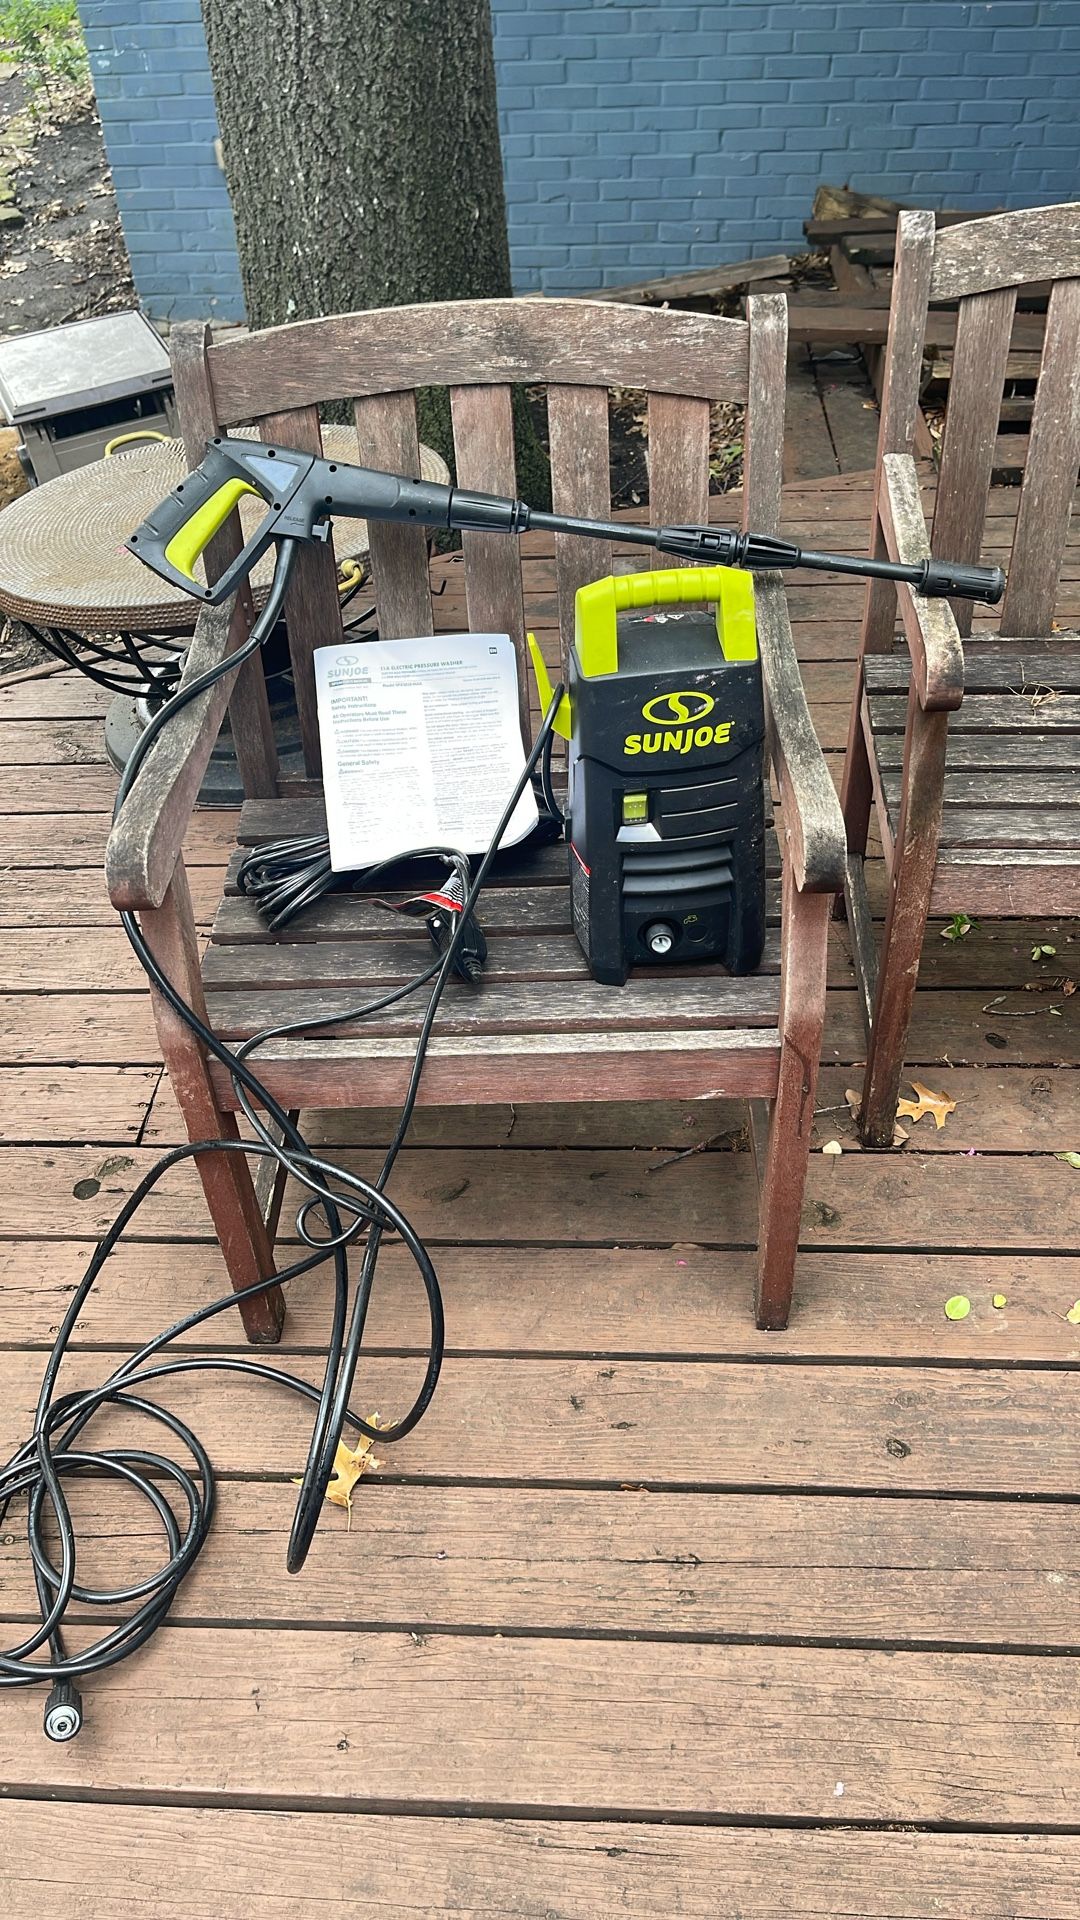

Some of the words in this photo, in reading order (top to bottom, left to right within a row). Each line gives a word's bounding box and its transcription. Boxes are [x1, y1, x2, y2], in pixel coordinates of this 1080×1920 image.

[327, 666, 369, 678] SUNJOE
[623, 722, 732, 755] SUNJOE
[361, 759, 380, 767] Safety
